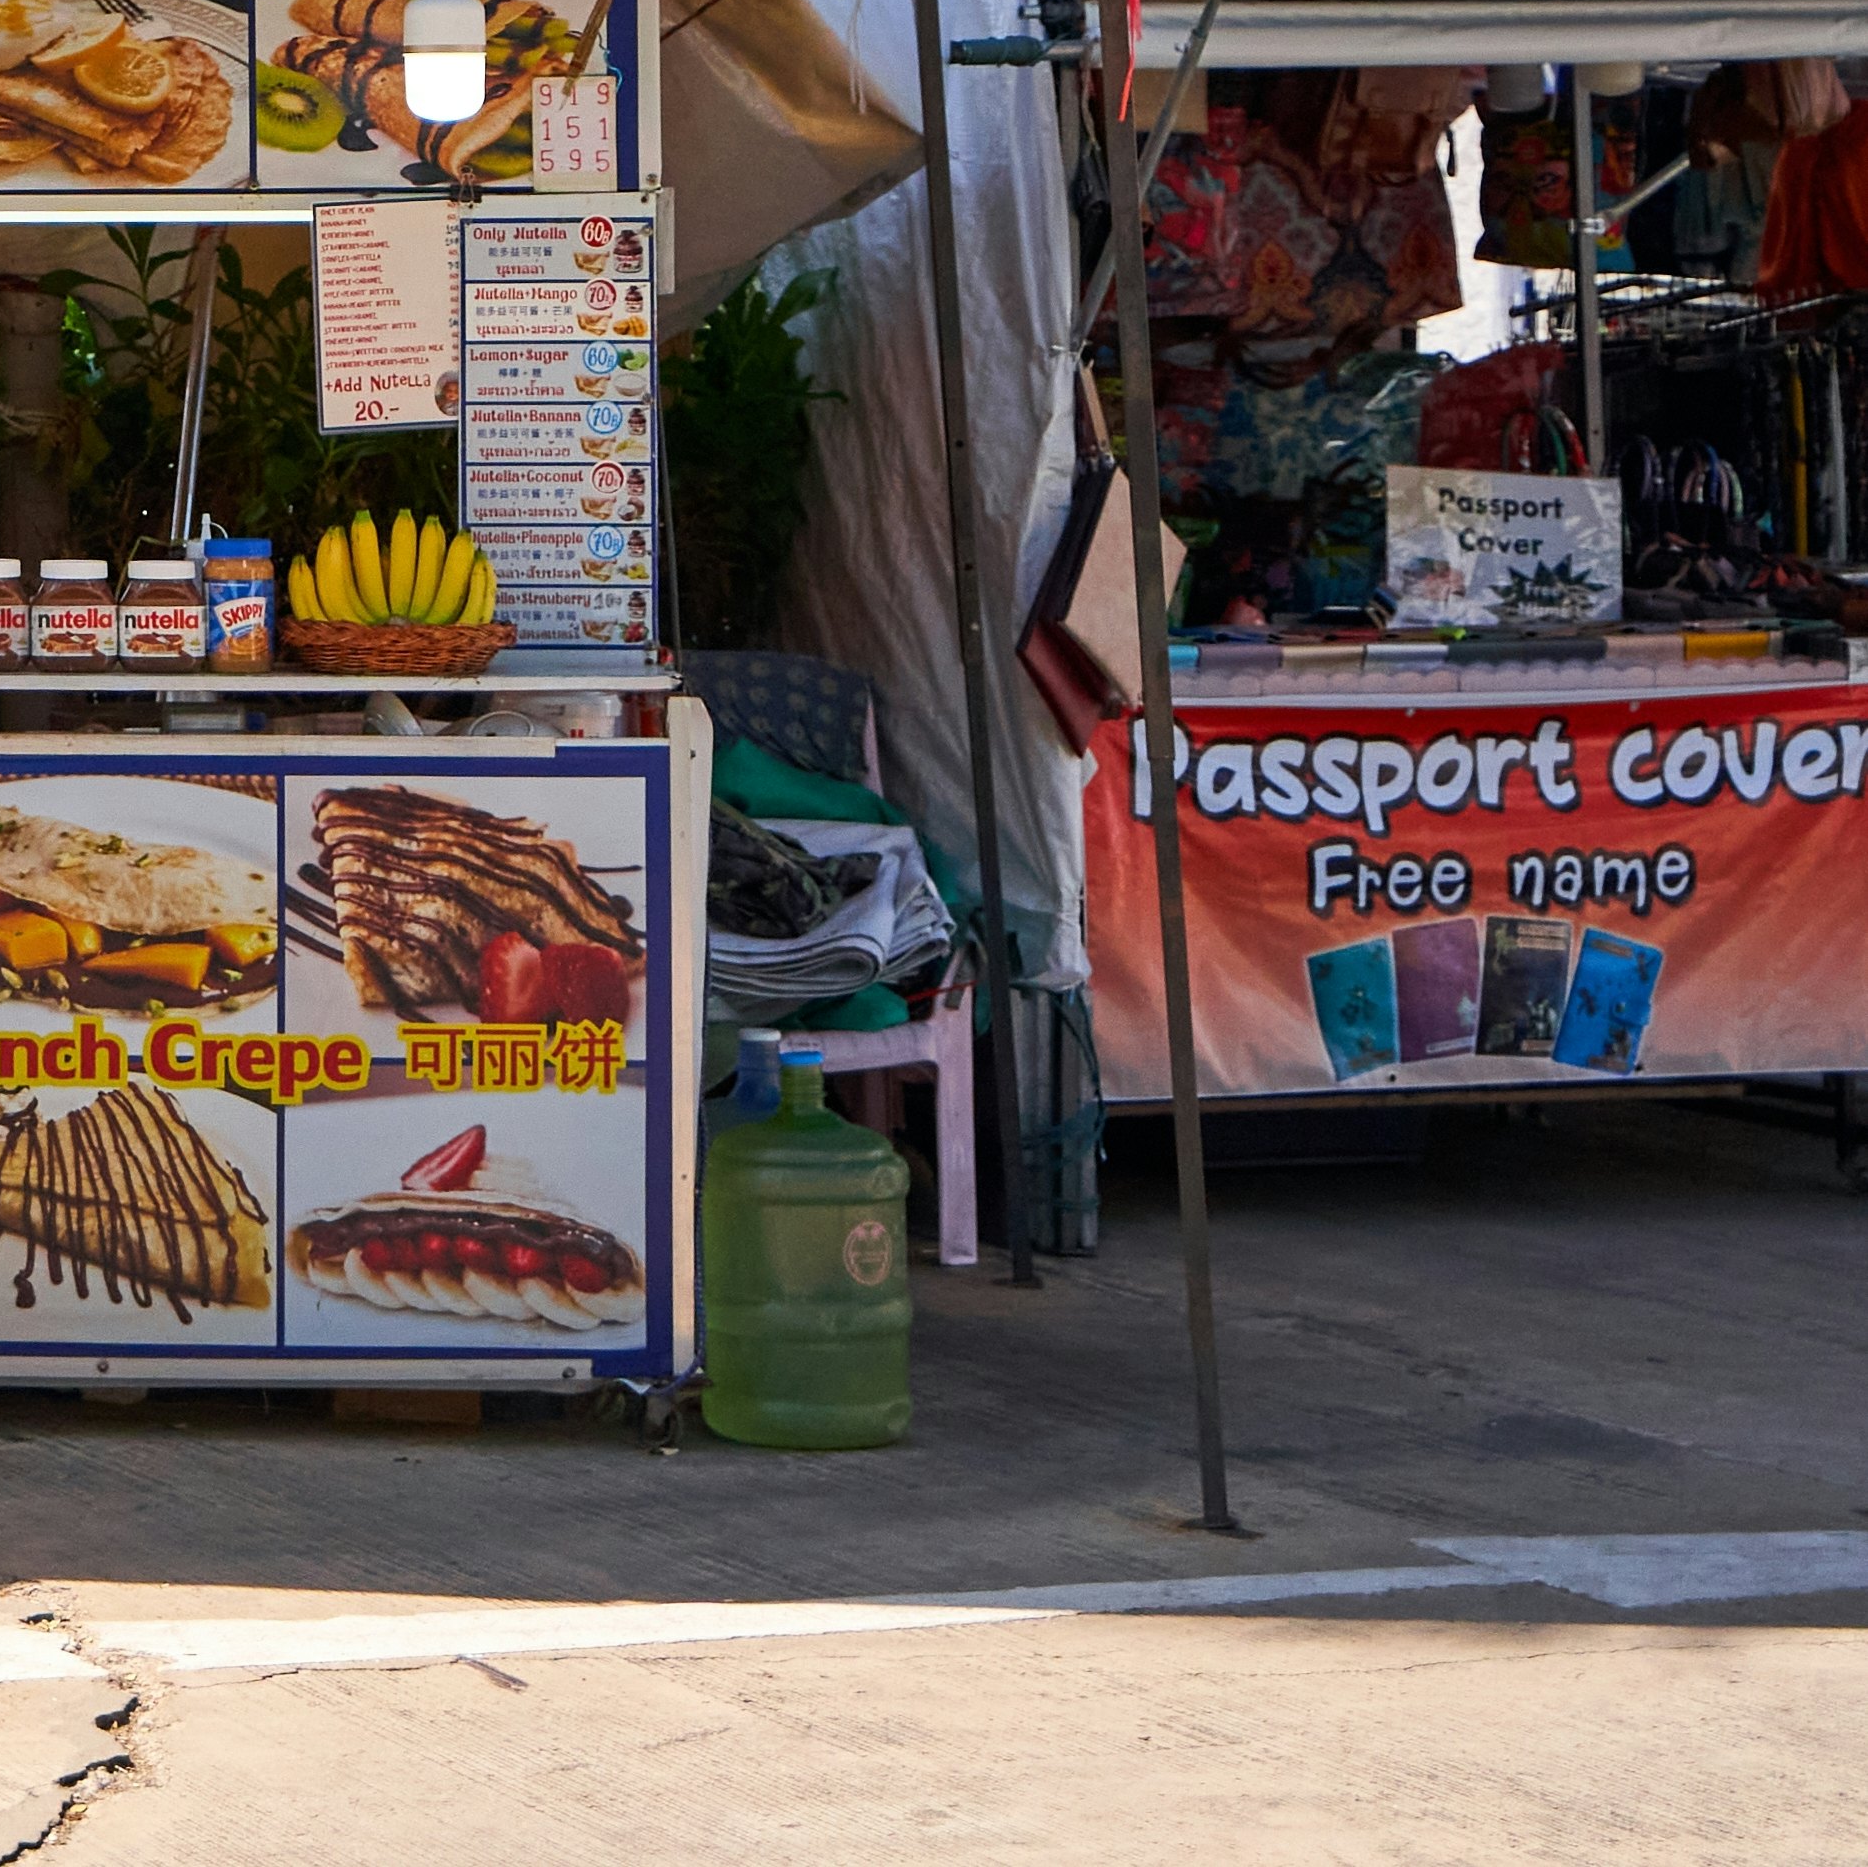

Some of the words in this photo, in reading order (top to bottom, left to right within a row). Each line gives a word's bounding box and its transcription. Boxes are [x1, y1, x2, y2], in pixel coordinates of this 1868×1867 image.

[473, 228, 506, 242] Only
[513, 227, 567, 239] Nutella
[584, 221, 611, 245] 60B
[1437, 487, 1564, 523] Passport
[1458, 527, 1544, 555] Cover
[38, 609, 112, 628] nutella
[125, 609, 199, 629] nutella
[222, 604, 263, 627] SKIPPY
[1311, 842, 1467, 910] Free
[1511, 845, 1693, 909] name
[150, 1023, 363, 1096] Crepe
[403, 1024, 619, 1089] 可丽饼
